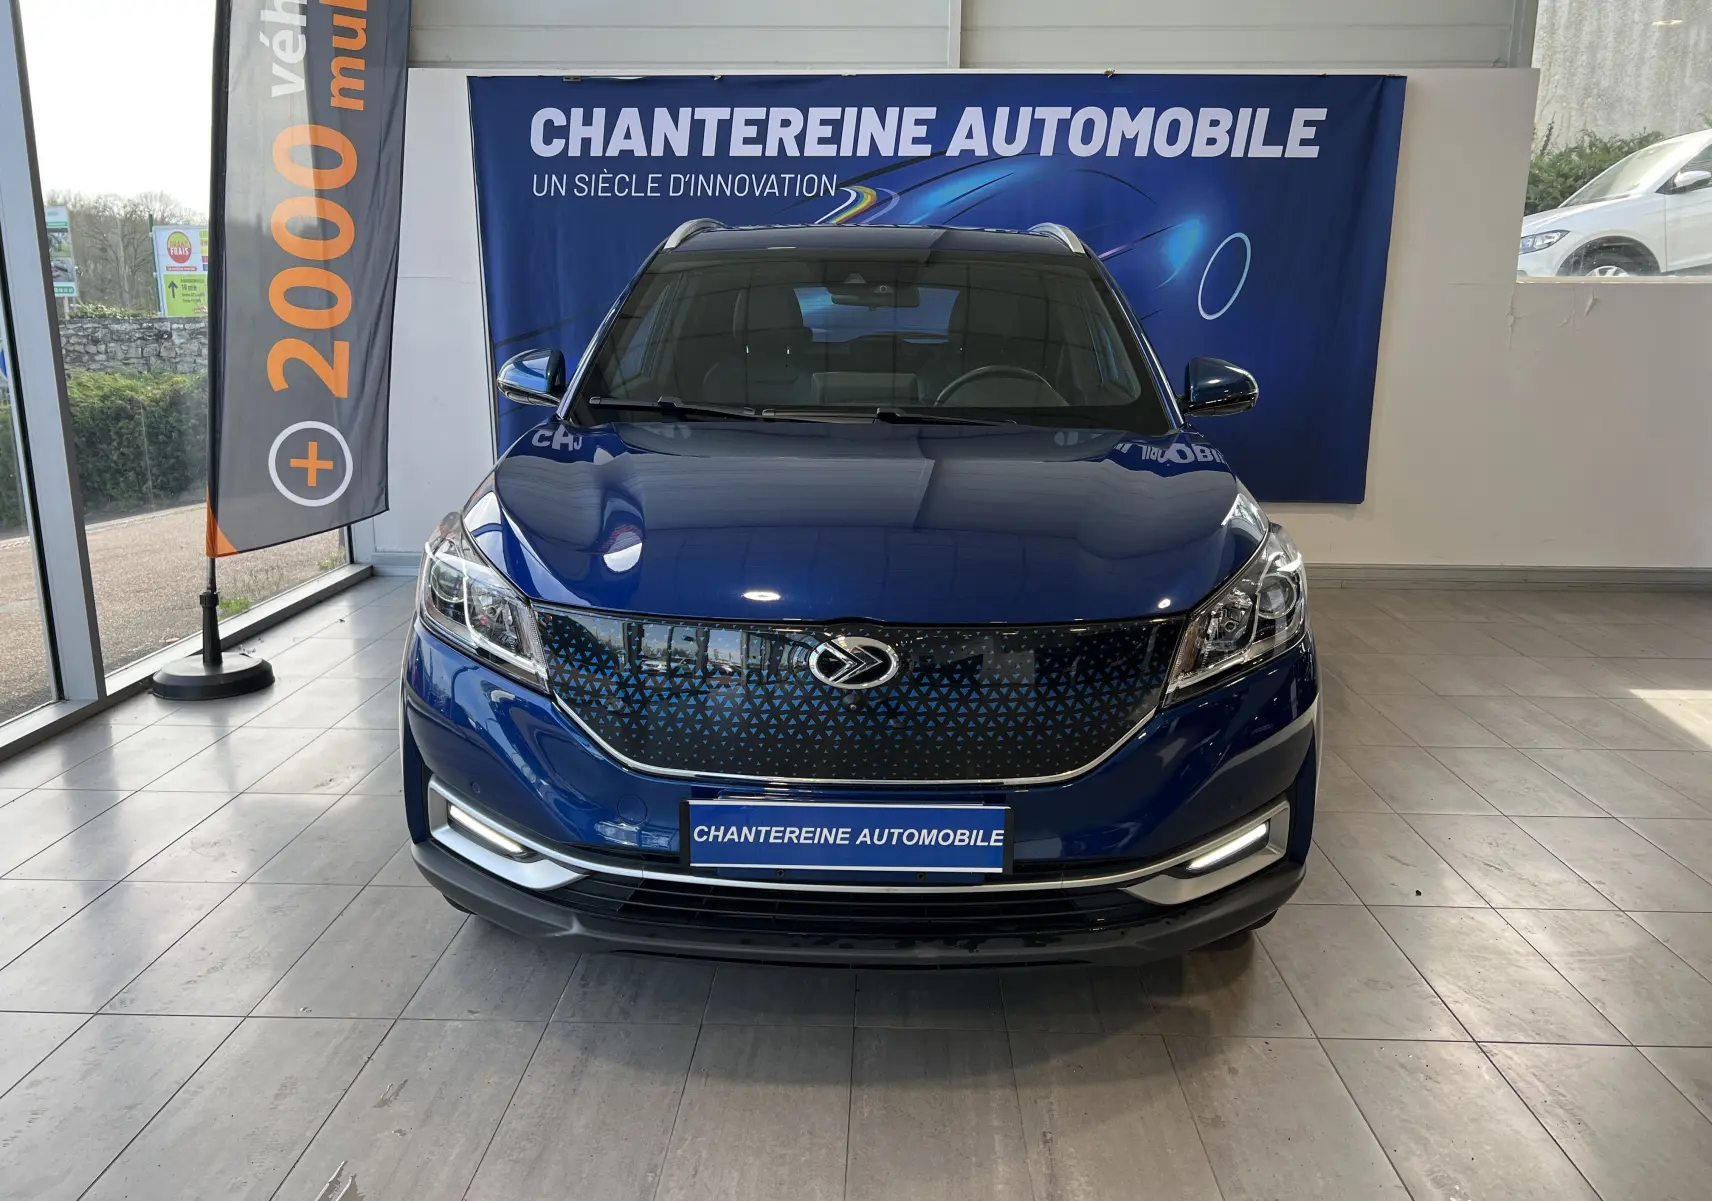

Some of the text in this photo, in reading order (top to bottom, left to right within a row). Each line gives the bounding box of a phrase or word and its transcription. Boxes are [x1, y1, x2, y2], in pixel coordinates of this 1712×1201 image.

[259, 0, 307, 97] véh
[530, 107, 1328, 158] CHANTEREINE AUTOMOBILE
[532, 169, 837, 197] UN SIÈCLE D'INNOVATION
[170, 247, 190, 256] FRAIS
[267, 124, 358, 399] 2000
[693, 825, 1005, 847] CHANTEREINE AUTOMOBILE
